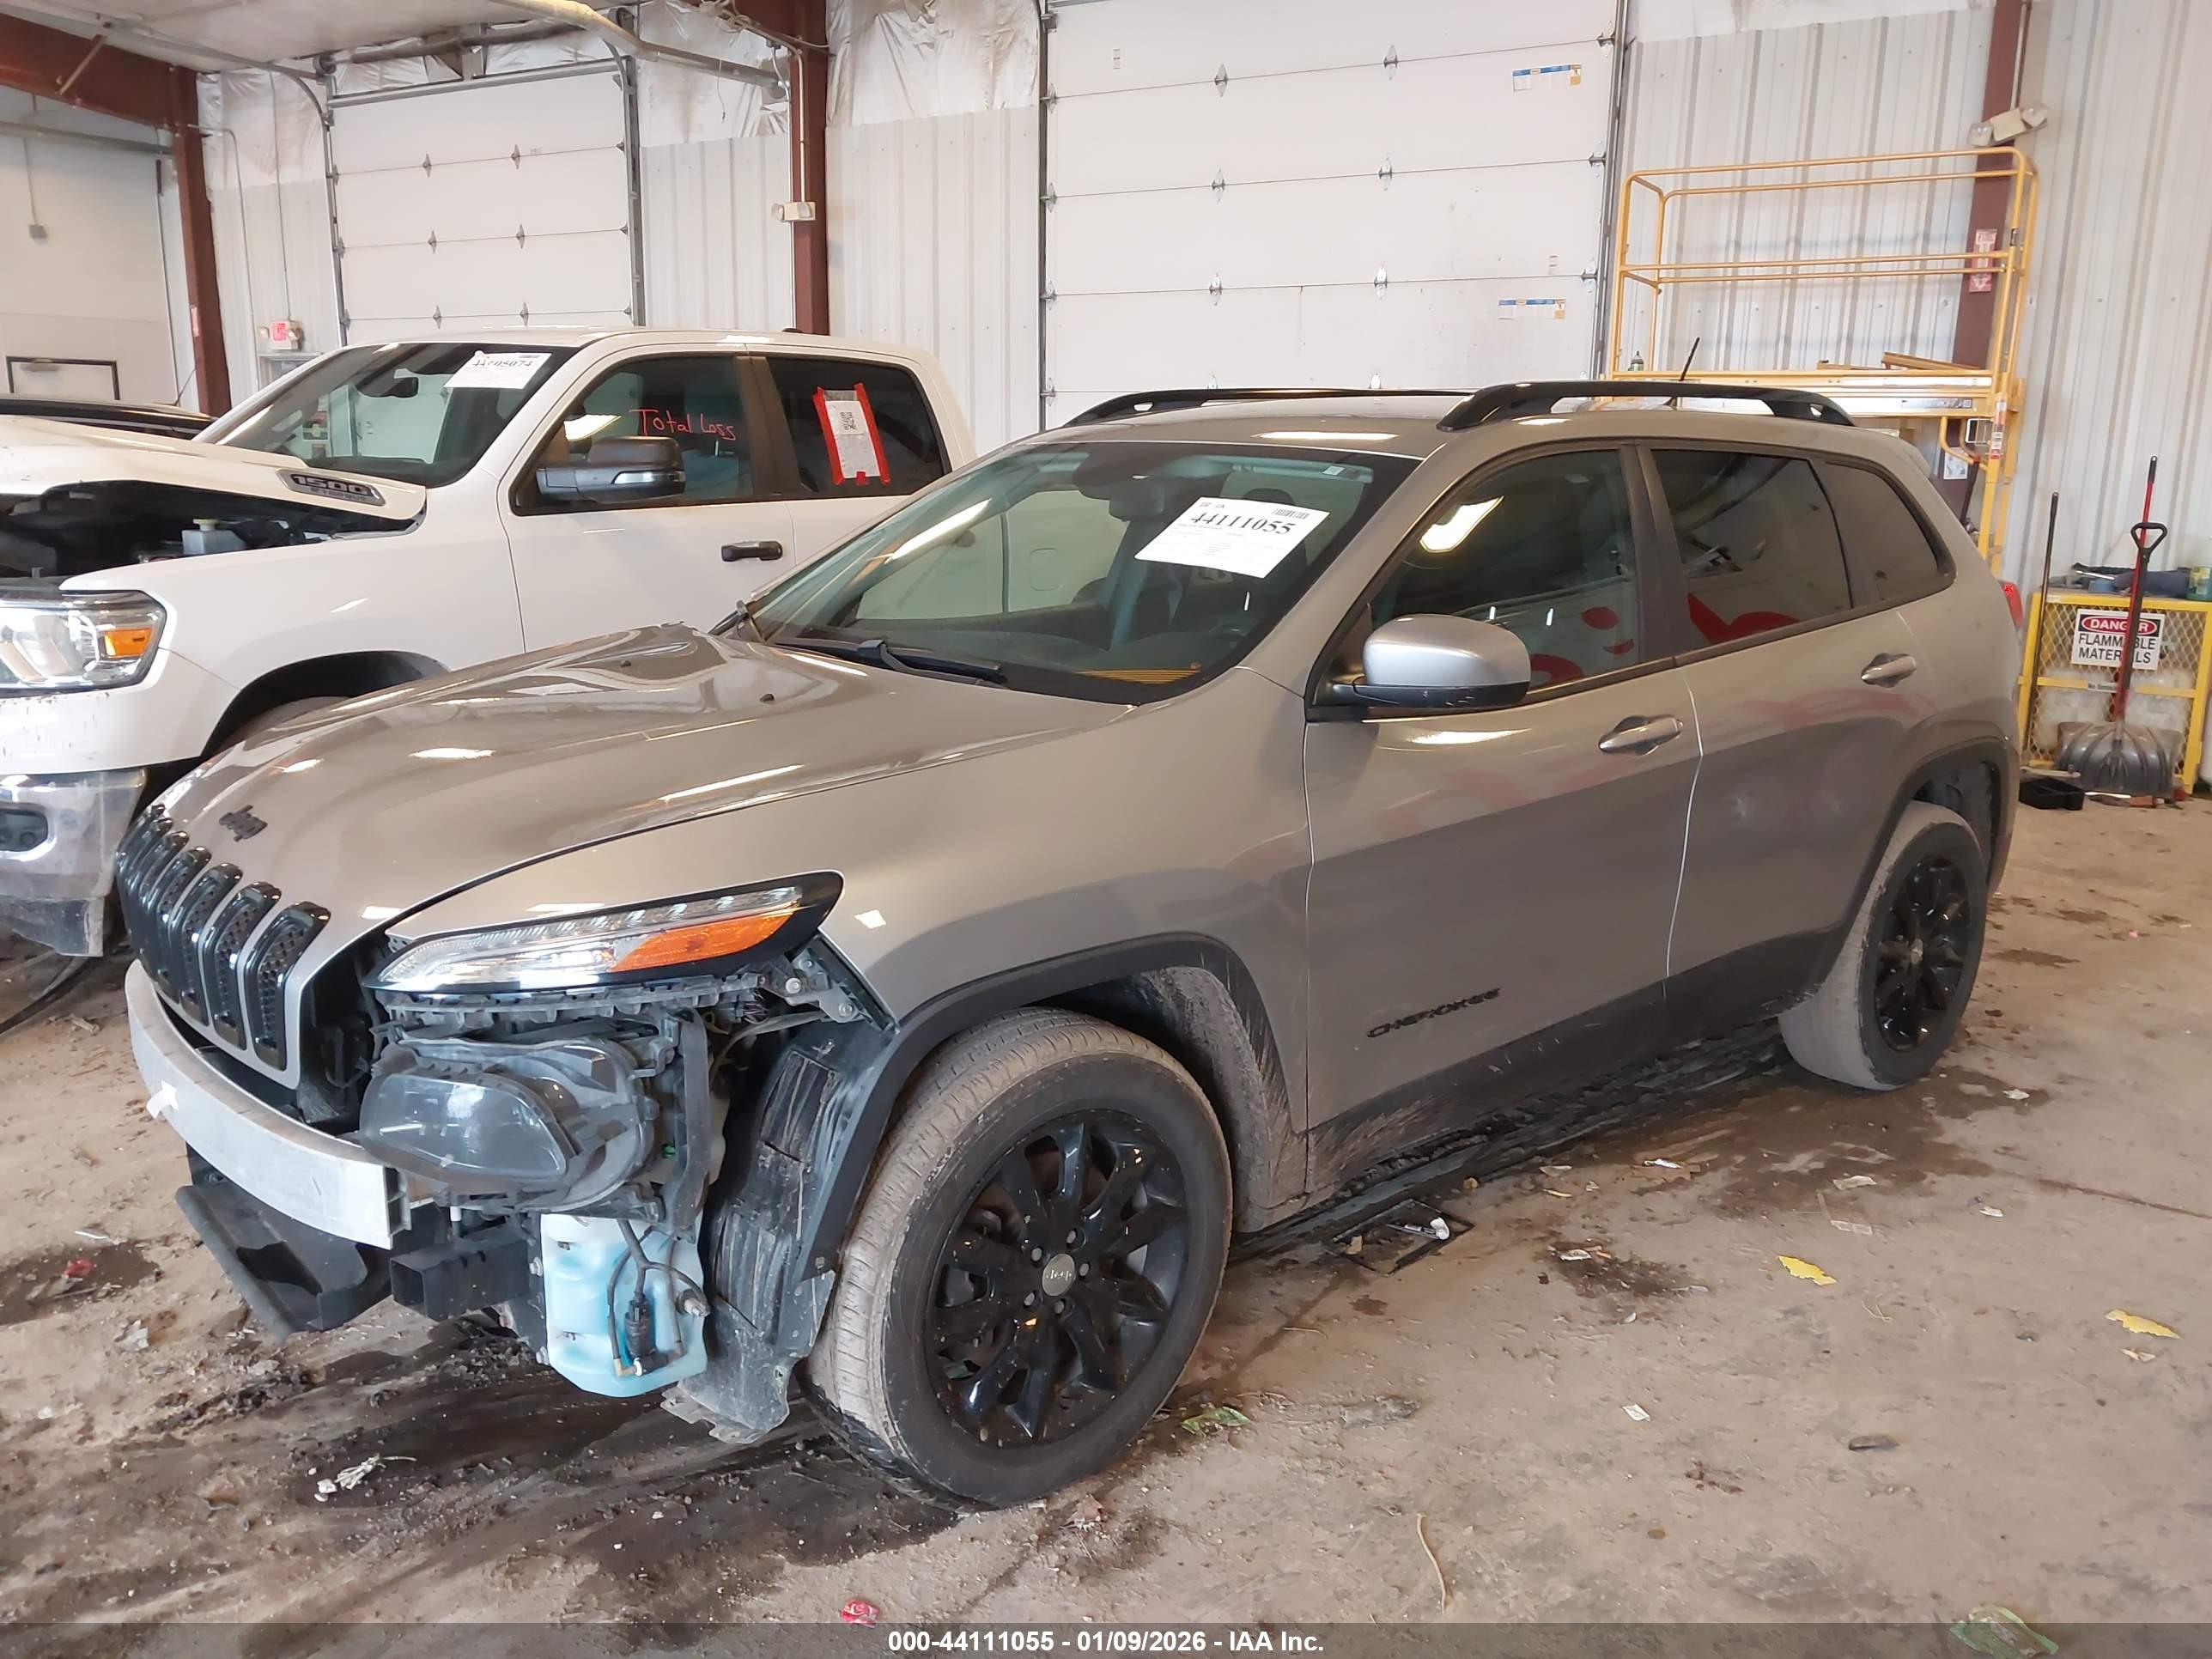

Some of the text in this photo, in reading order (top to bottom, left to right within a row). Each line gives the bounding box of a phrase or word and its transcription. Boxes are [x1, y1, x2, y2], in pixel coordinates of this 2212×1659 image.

[629, 409, 736, 441] Total Loss
[292, 475, 369, 495] 1500
[1190, 512, 1296, 535] 44111055
[2090, 618, 2148, 632] DANGR
[2078, 633, 2156, 650] FLAMMBLE
[2078, 647, 2151, 664] MATERLS
